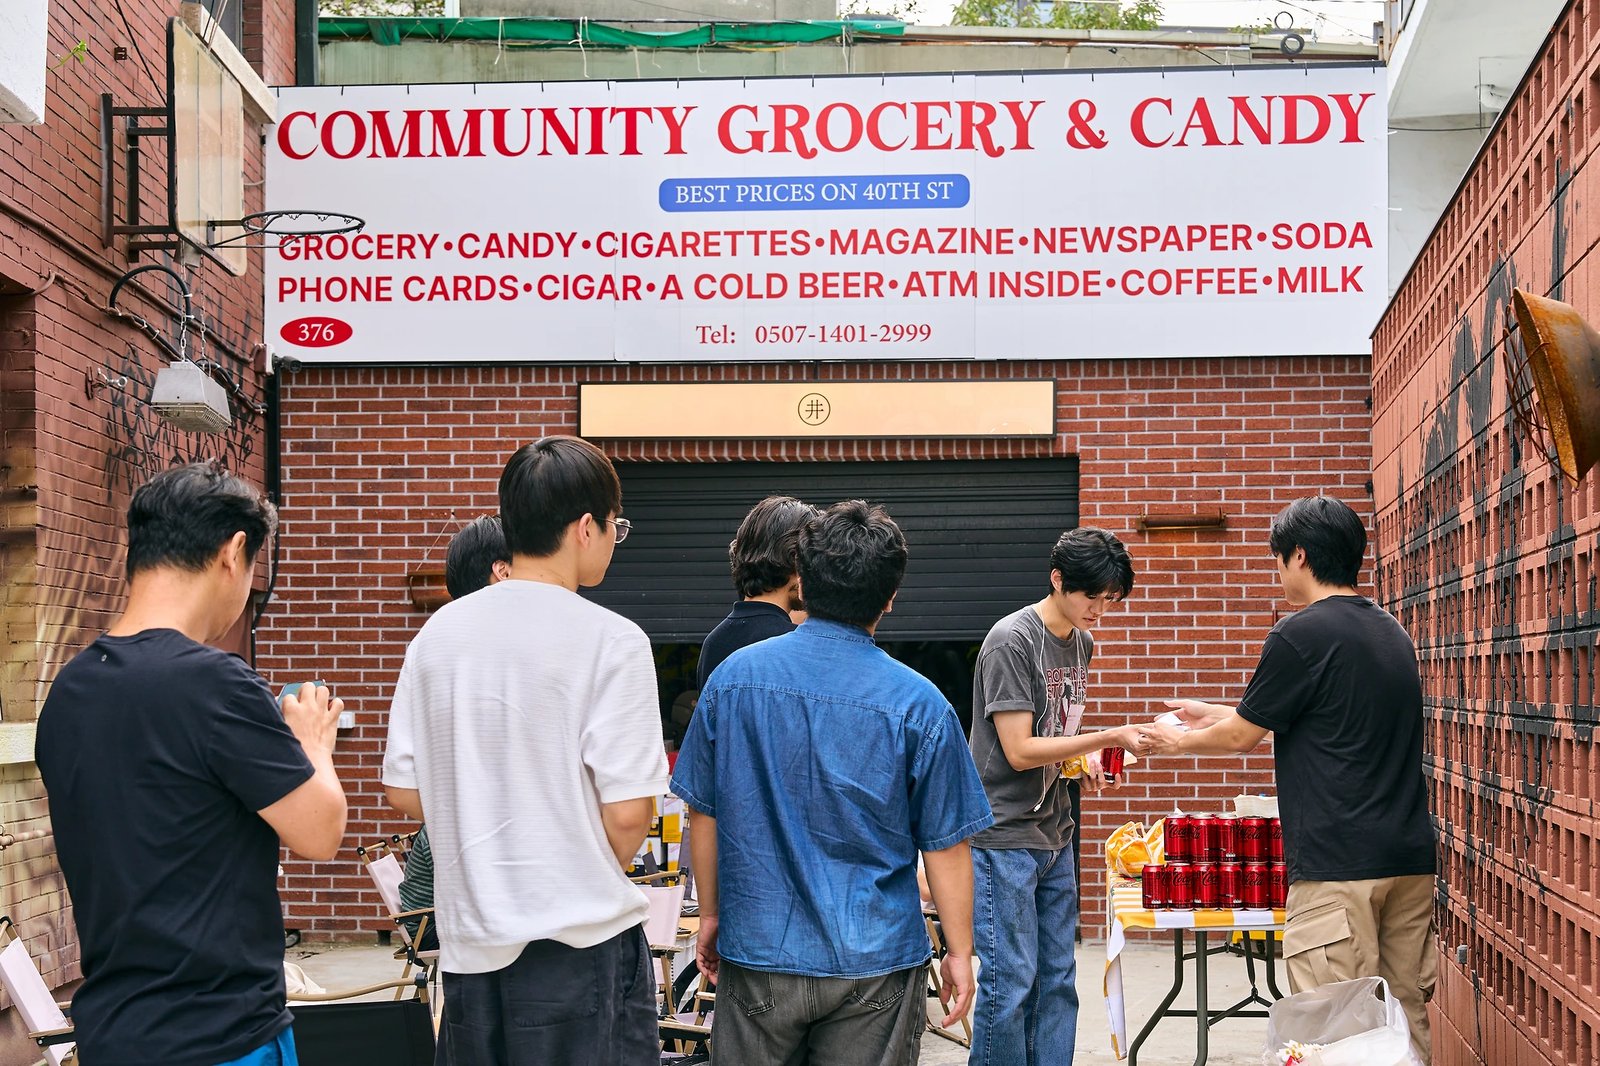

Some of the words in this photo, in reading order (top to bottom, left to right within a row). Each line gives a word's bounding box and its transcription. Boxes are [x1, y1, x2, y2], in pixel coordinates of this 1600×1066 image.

[276, 105, 698, 161] COMMUNITY
[717, 100, 1045, 161] GROCERY
[1065, 98, 1108, 150] &
[1129, 92, 1375, 149] CANDY
[675, 184, 730, 204] BEST
[735, 183, 816, 203] PRICES
[820, 183, 858, 202] ON
[862, 182, 921, 201] 40TH
[926, 181, 954, 200] ST
[278, 233, 440, 262] GROCERY
[457, 231, 577, 260] CANDY
[595, 229, 811, 259] CIGARETTES
[829, 227, 1014, 256] MAGAZINE
[1033, 223, 1253, 255] NEWSPAPER
[1271, 221, 1373, 251] SODA
[278, 275, 393, 304] PHONE
[402, 274, 520, 303] CARDS
[536, 273, 642, 302] CIGAR
[660, 273, 684, 301] A
[693, 272, 789, 301] COLD
[798, 271, 885, 299] BEER
[903, 270, 978, 299] ATM
[989, 269, 1101, 299] INSIDE
[1120, 267, 1258, 297] COFFEE
[1277, 265, 1363, 295] MILK
[298, 323, 336, 342] 376
[695, 323, 737, 346] Tel:
[754, 323, 933, 344] 0507-1401-2999
